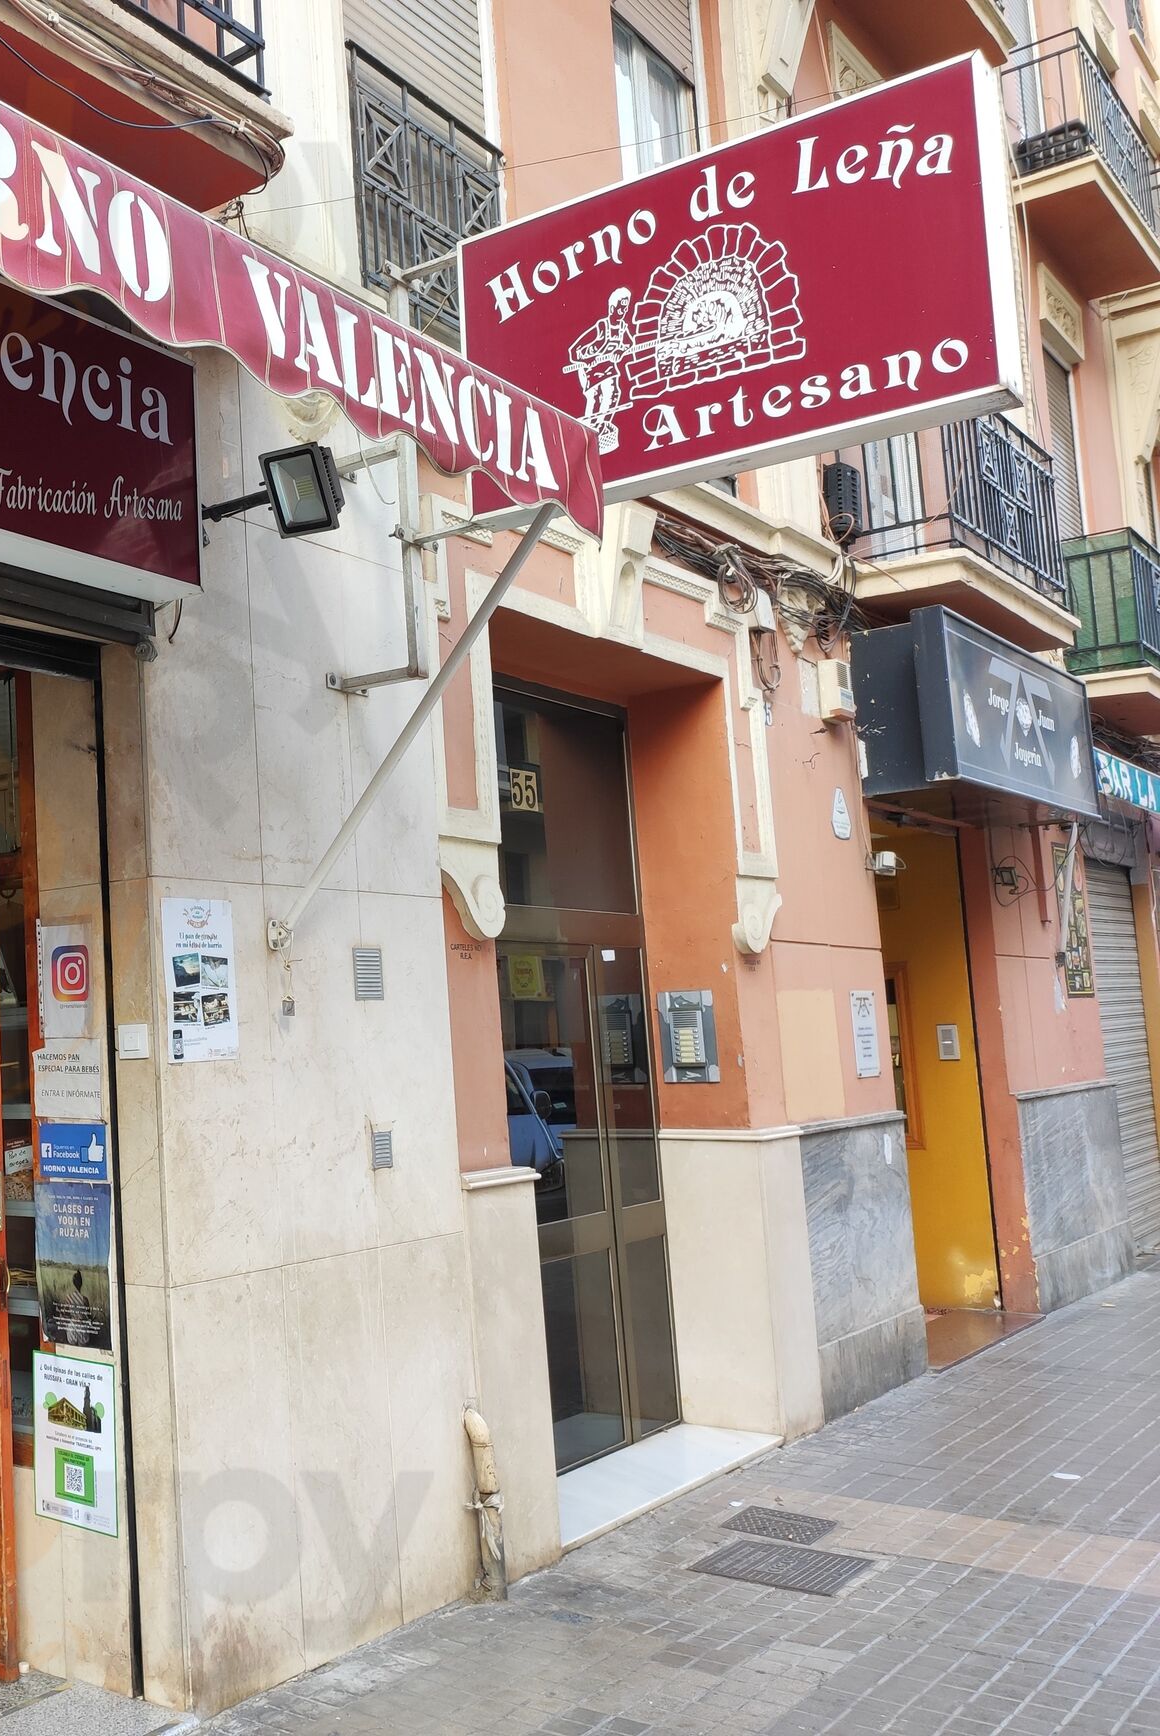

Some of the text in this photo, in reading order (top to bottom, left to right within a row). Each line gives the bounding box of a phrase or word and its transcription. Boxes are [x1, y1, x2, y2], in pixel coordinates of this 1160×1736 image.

[484, 124, 954, 324] Horno de Leña
[242, 254, 560, 491] VALENCIA
[642, 338, 970, 452] Artesano
[104, 476, 184, 522] Artesana
[988, 688, 1009, 716] Jorge
[512, 772, 536, 808] 55
[82, 1064, 100, 1072] BEBÉS
[66, 1088, 100, 1098] INFÓRMATE
[68, 1166, 100, 1174] VALENCIA
[54, 1204, 94, 1214] CLASES DE
[58, 1216, 90, 1226] YOGA EN
[59, 1228, 90, 1238] RUZAFA
